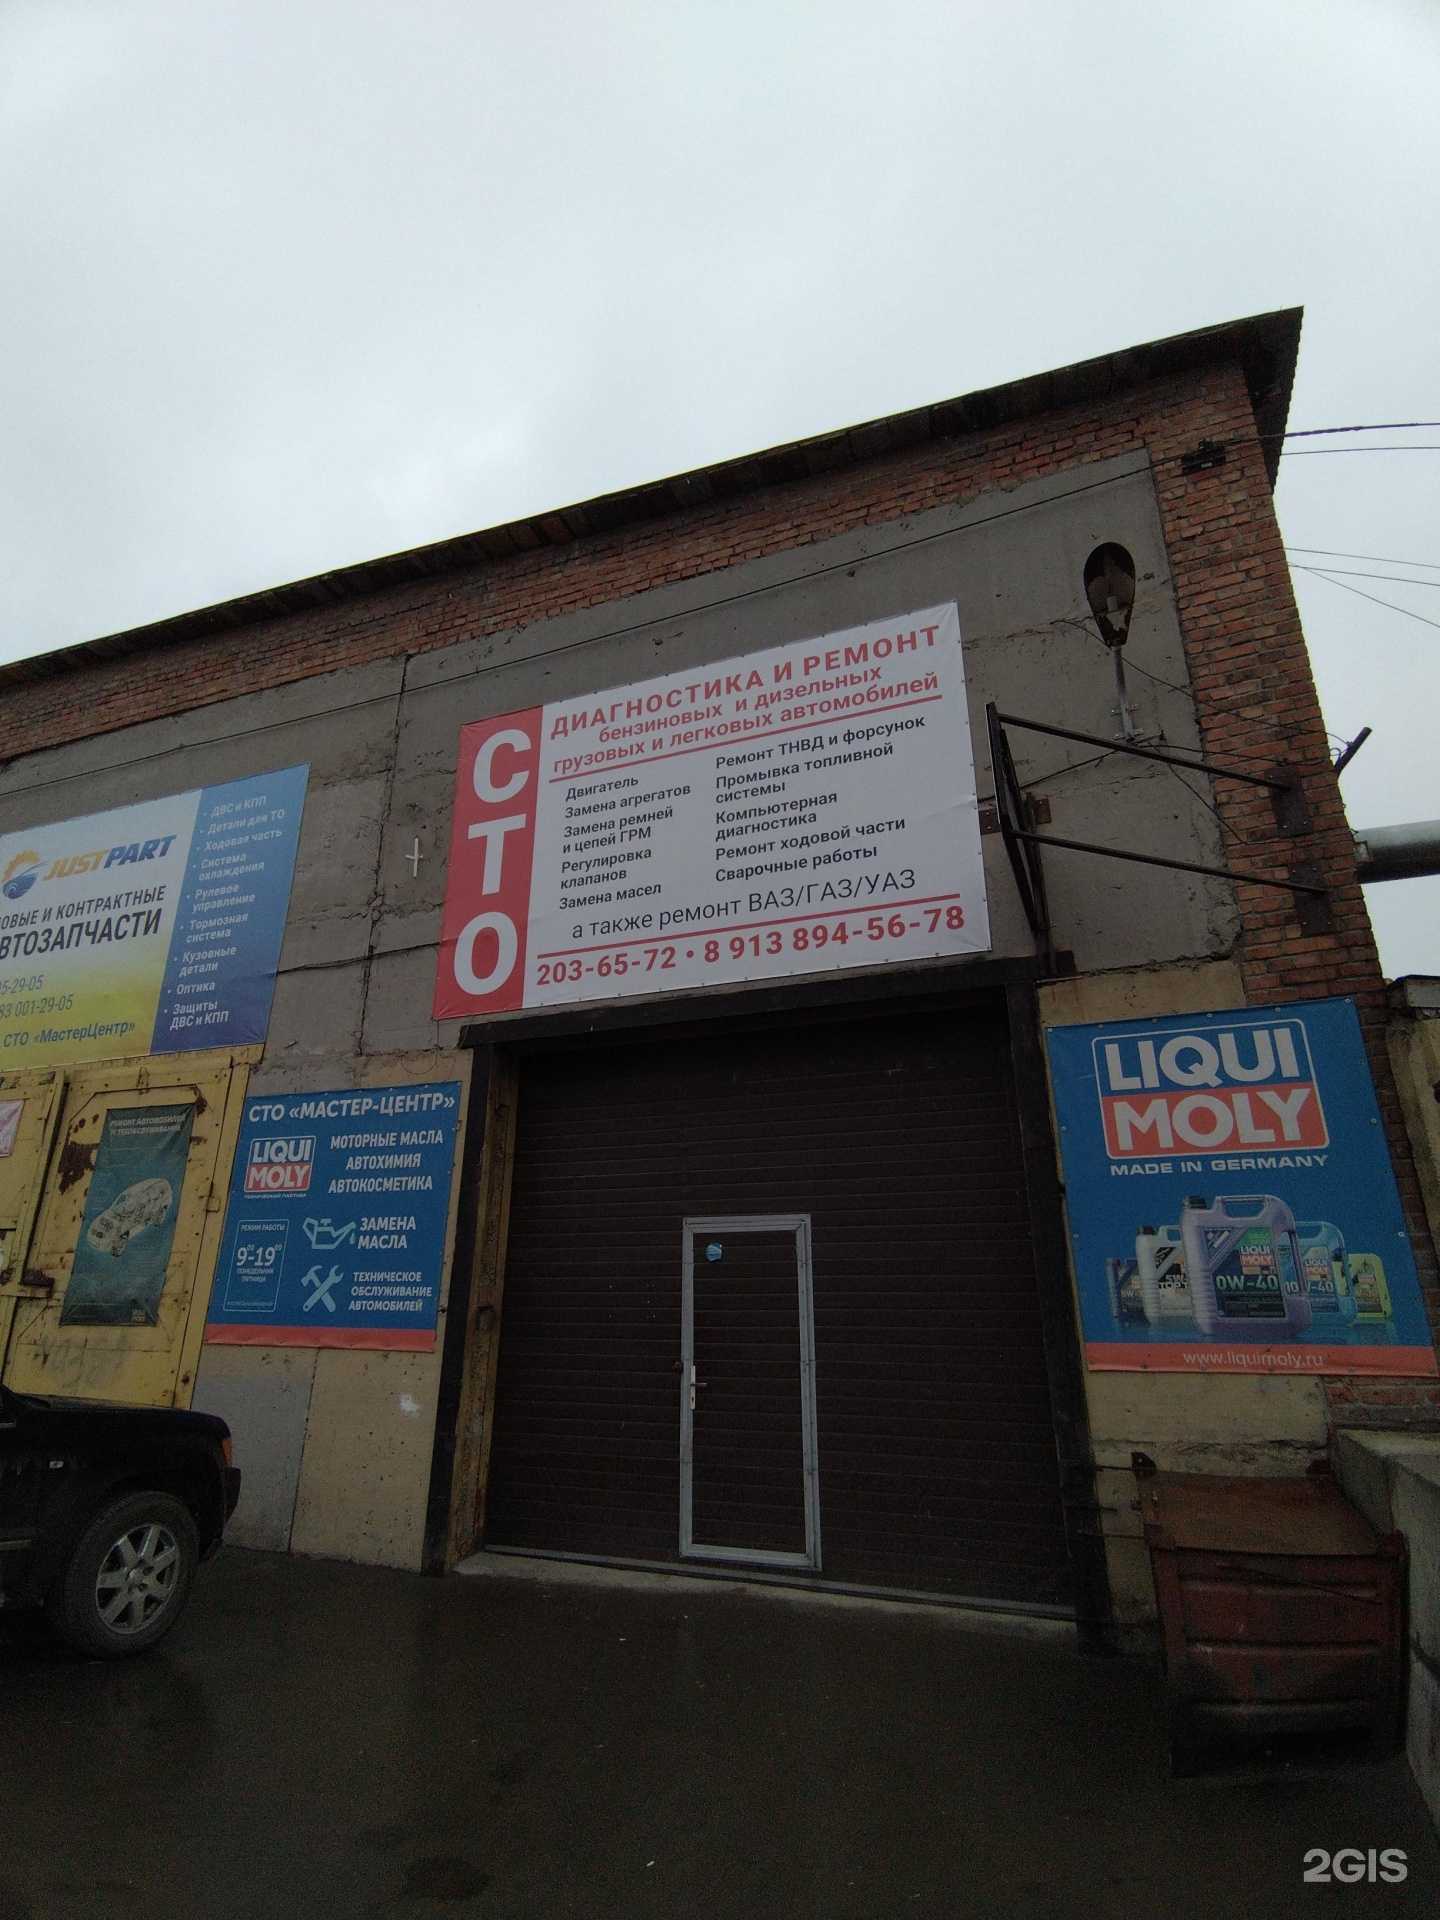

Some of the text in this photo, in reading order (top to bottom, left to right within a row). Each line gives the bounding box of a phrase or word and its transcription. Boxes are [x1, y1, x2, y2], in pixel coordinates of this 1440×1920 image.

[550, 625, 940, 739] ДИАГНОСТИКА И РЕМОНТ
[599, 666, 882, 743] бензиновых и дизельных
[553, 672, 939, 774] грузовых и легковых автомобилей
[716, 715, 926, 769] Ремонт ТНВД и форсунок
[716, 742, 894, 789] Промывка топливной
[565, 776, 639, 801] Двигатель
[715, 782, 786, 804] системы
[565, 785, 691, 819] Замена агрегатов
[716, 792, 838, 825] Компьютерная
[208, 818, 246, 835] Детали
[564, 806, 674, 838] Замена ремней
[715, 811, 817, 842] диагностика
[205, 829, 283, 851] Ходовая часть
[563, 826, 651, 854] и цепей ГРМ
[716, 817, 905, 861] Ремонт ходовой части
[199, 861, 265, 881] охлаждения
[201, 853, 247, 869] Система
[453, 728, 532, 996] СТО
[561, 848, 652, 874] Регулировка
[715, 844, 878, 882] Сварочные работы
[560, 869, 627, 890] клапанов
[192, 894, 256, 912] управление
[195, 884, 240, 900] Рулевое
[559, 883, 662, 910] Замена масел
[41, 907, 52, 923] И
[55, 885, 167, 921] КОНТРАКТНЫЕ
[572, 869, 916, 939] а также ремонт ВАЗ/ГАЗ/УАЗ
[190, 913, 249, 931] Тормозная
[186, 928, 232, 944] система
[537, 905, 965, 986] 203-65-72 8 913 894-56-78
[182, 946, 238, 965] Кузовные
[179, 961, 219, 978] детали
[176, 982, 216, 995] Оптика
[15, 993, 74, 1017] 001-29-05
[172, 1001, 218, 1015] Защиты
[170, 1010, 230, 1031] ДВС и КПП
[3, 1031, 29, 1048] СТО
[1104, 1027, 1300, 1091] LIQUI
[249, 1092, 456, 1122] СТО «МАСТЕР-ЦЕНТР»
[1113, 1087, 1313, 1151] MOLY
[330, 1129, 444, 1150] МОТОРНЫЕ МАСЛА
[252, 1139, 312, 1164] LIQUI
[346, 1153, 421, 1171] АВТОХИМИЯ
[1110, 1154, 1329, 1176] MADE IN GERMANY
[247, 1164, 310, 1190] MOLY
[328, 1175, 433, 1194] АВТОКОСМЕТИКА
[359, 1216, 417, 1231] ЗАМЕНА
[357, 1234, 408, 1249] МАСЛА
[353, 1271, 423, 1282] ТЕХНИЧЕСКОЕ
[1216, 1274, 1278, 1291] 0W-40
[351, 1286, 433, 1297] ОБСЛУЖИВАНИЕ
[348, 1298, 424, 1311] АВТОМОБИЛЕЙ
[1184, 1349, 1324, 1368] www.liquimoly.ru
